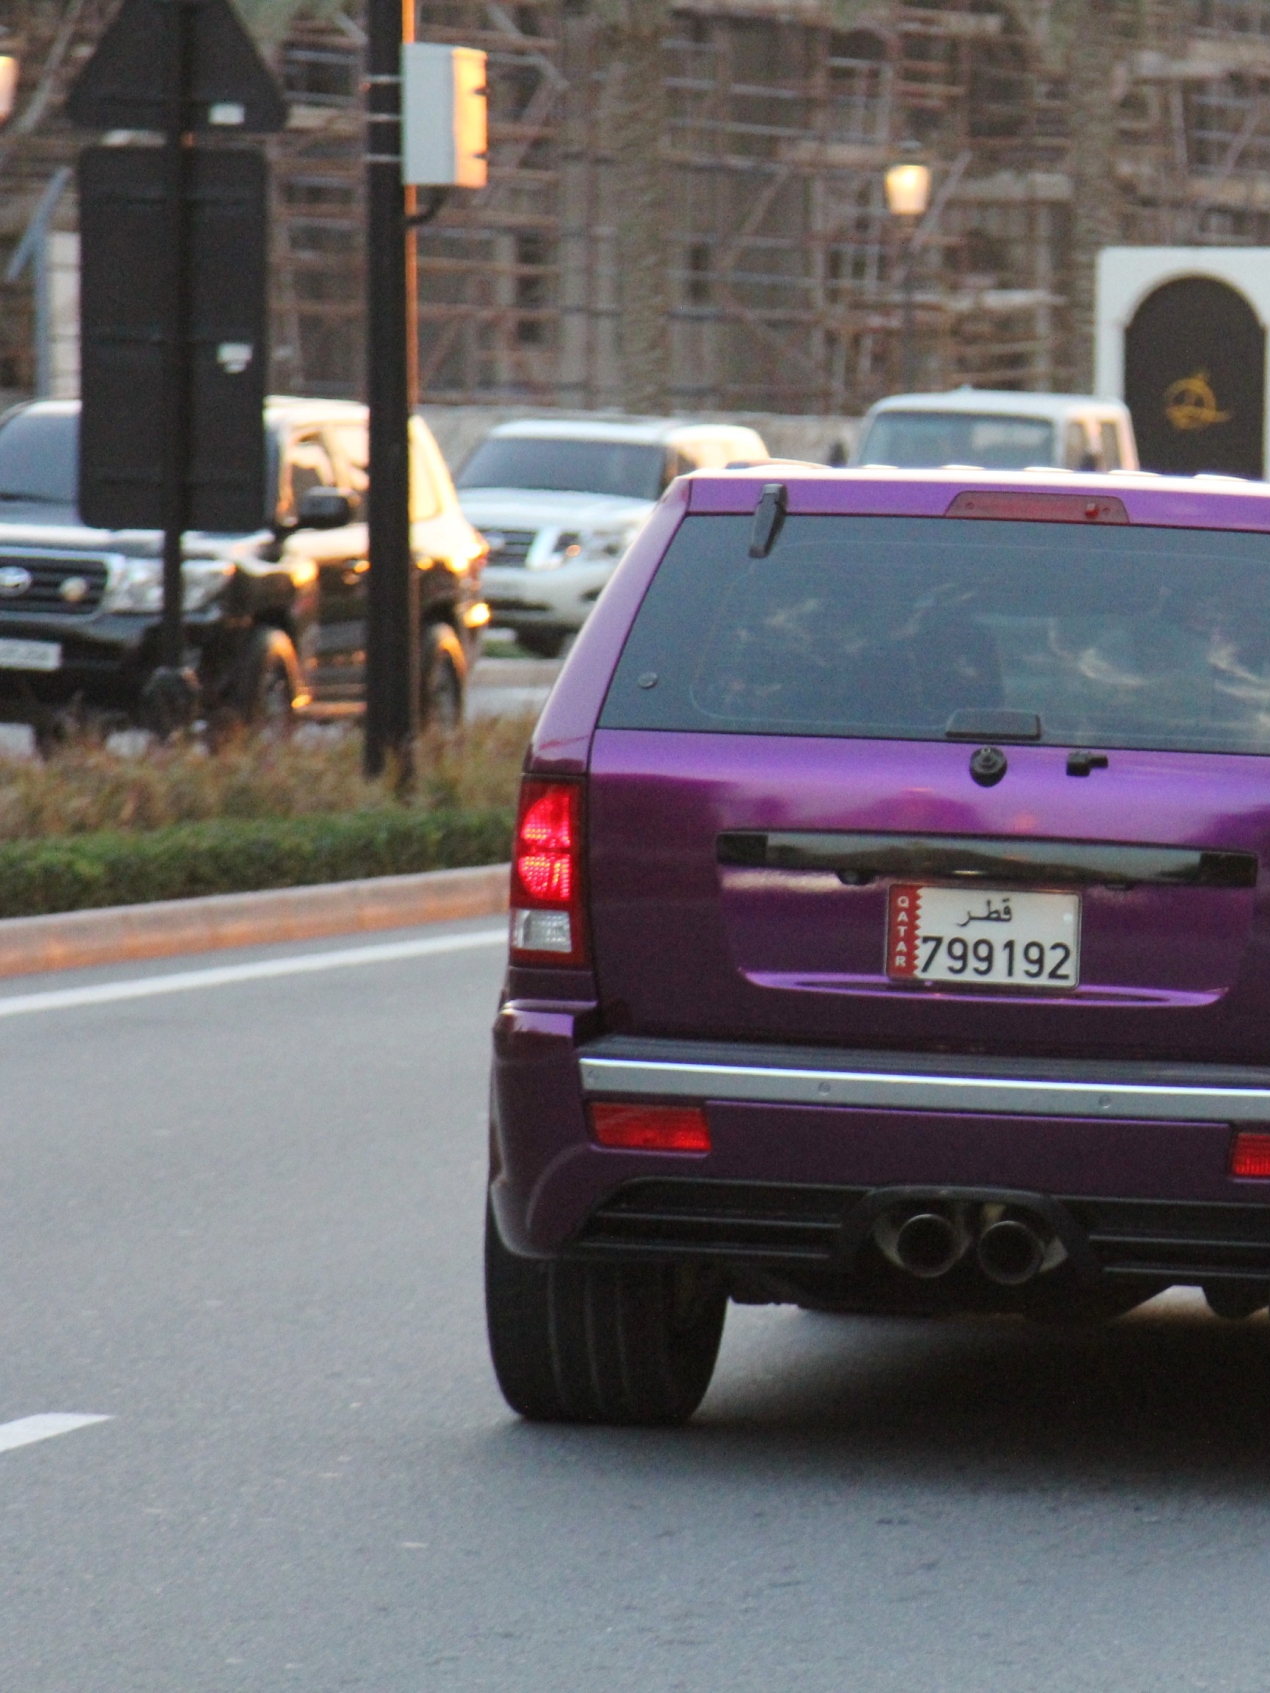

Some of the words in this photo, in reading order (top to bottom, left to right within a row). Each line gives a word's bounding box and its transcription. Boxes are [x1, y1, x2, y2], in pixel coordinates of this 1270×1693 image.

[895, 896, 910, 967] QATAR
[956, 898, 1013, 927] قطر
[920, 935, 1071, 980] 799192
